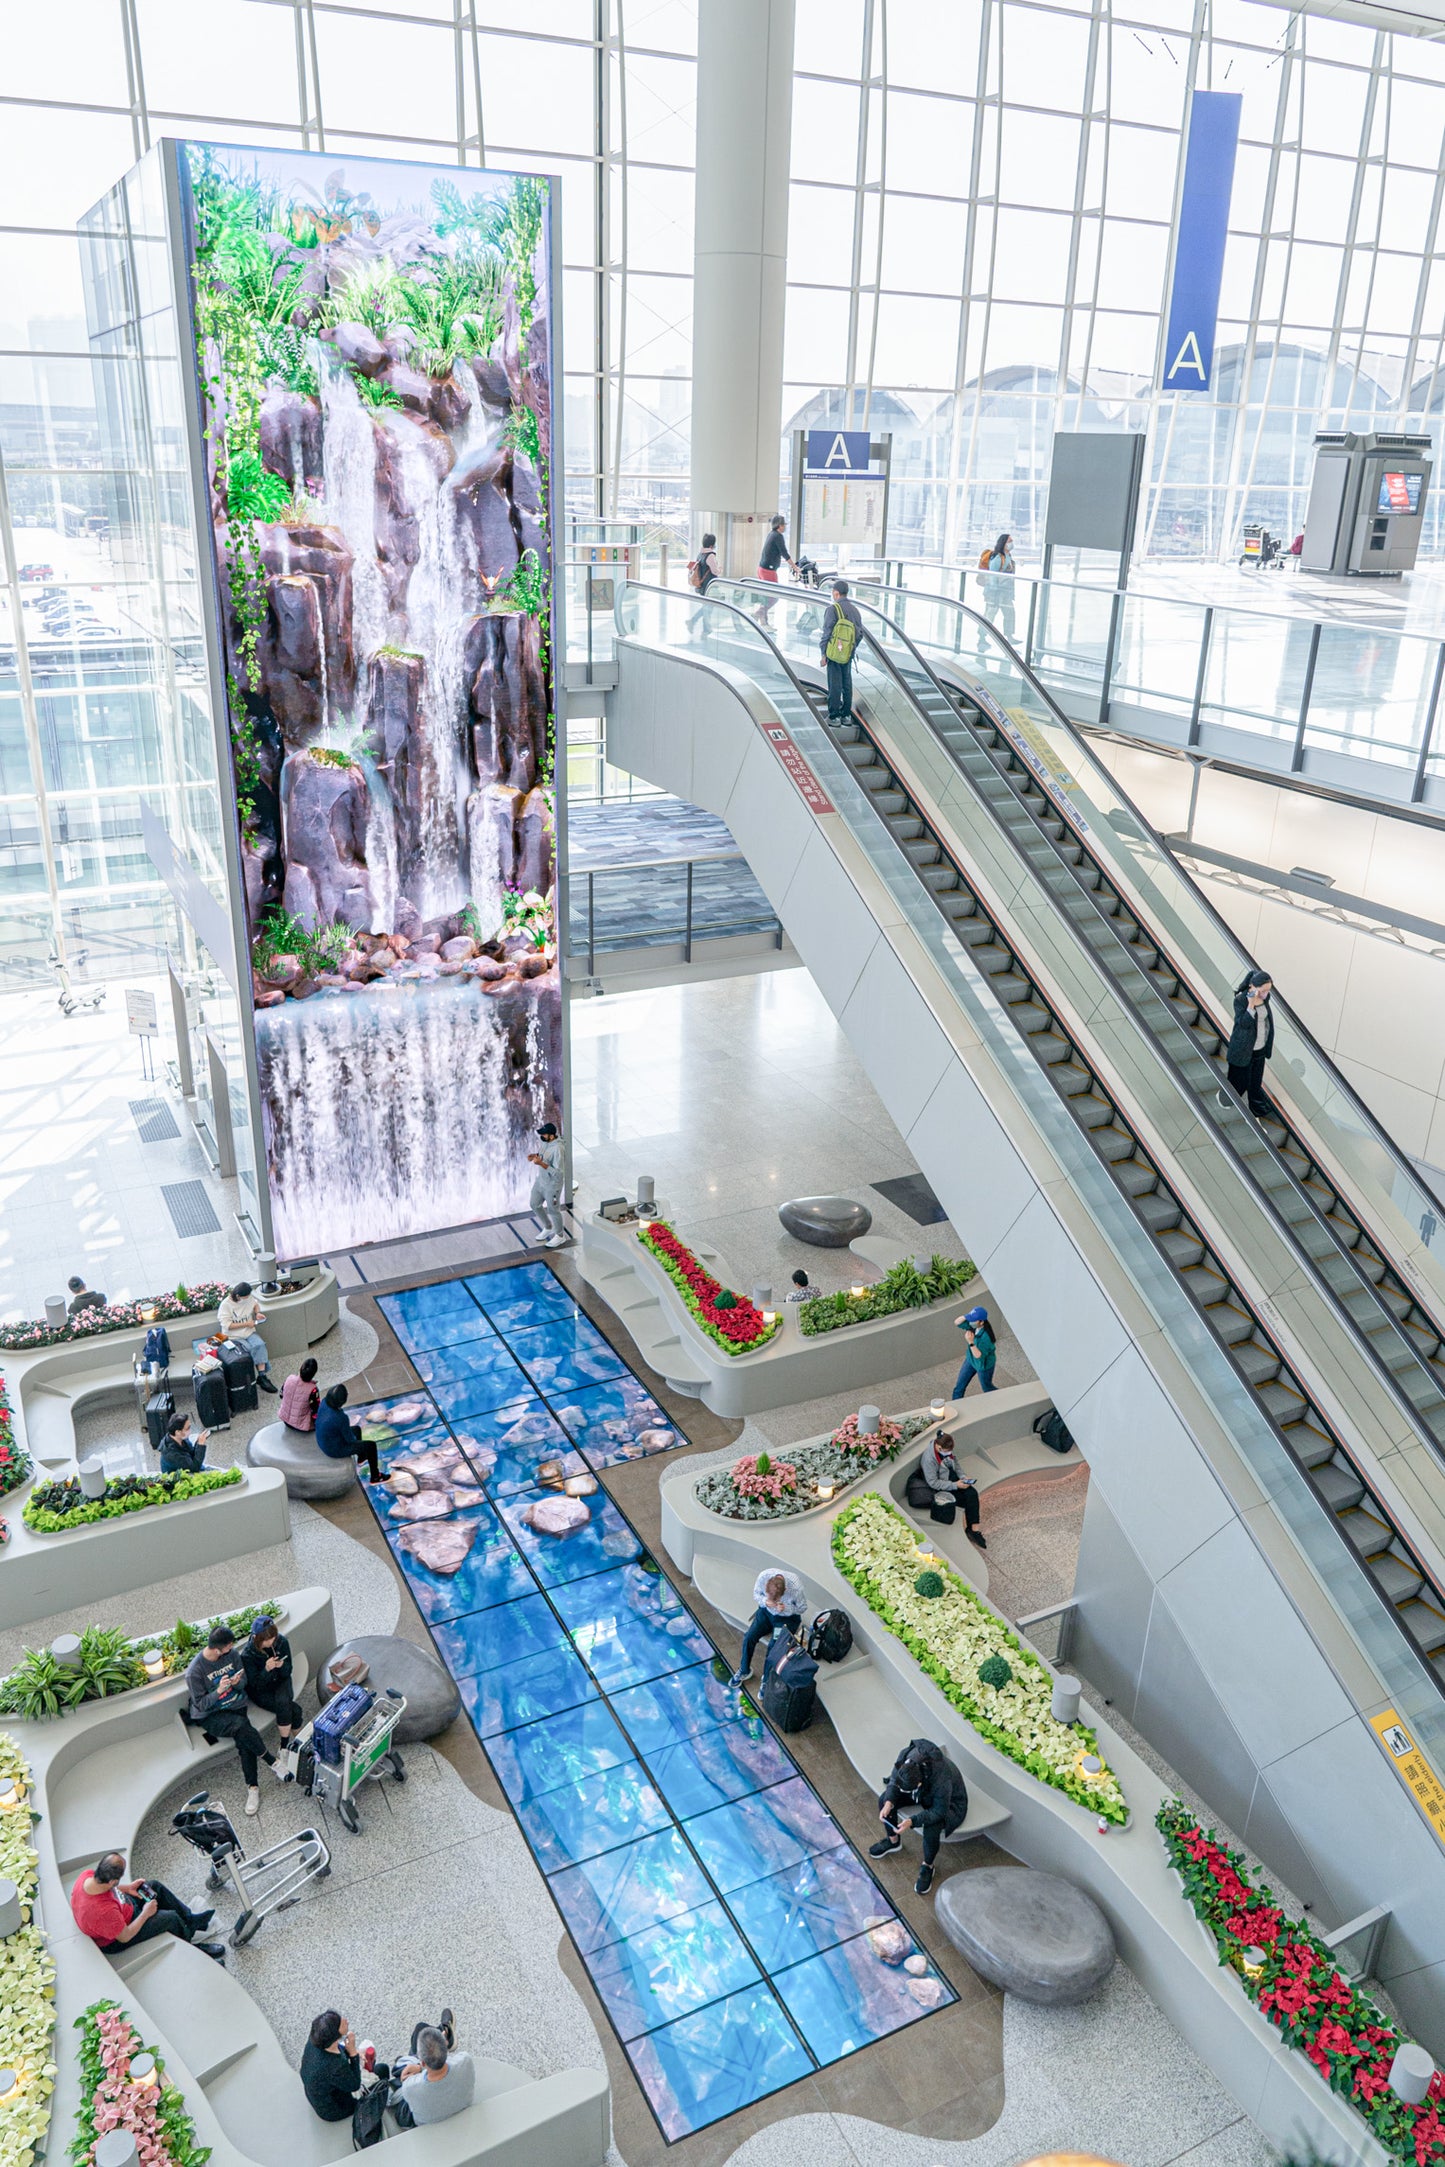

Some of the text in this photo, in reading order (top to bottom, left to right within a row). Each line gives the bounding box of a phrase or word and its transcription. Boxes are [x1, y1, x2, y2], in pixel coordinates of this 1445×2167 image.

[1167, 331, 1206, 381] A
[825, 433, 852, 468] A
[797, 761, 807, 769] the
[806, 776, 818, 788] clear
[814, 789, 829, 805] Stand
[1413, 1754, 1444, 1801] the elderly
